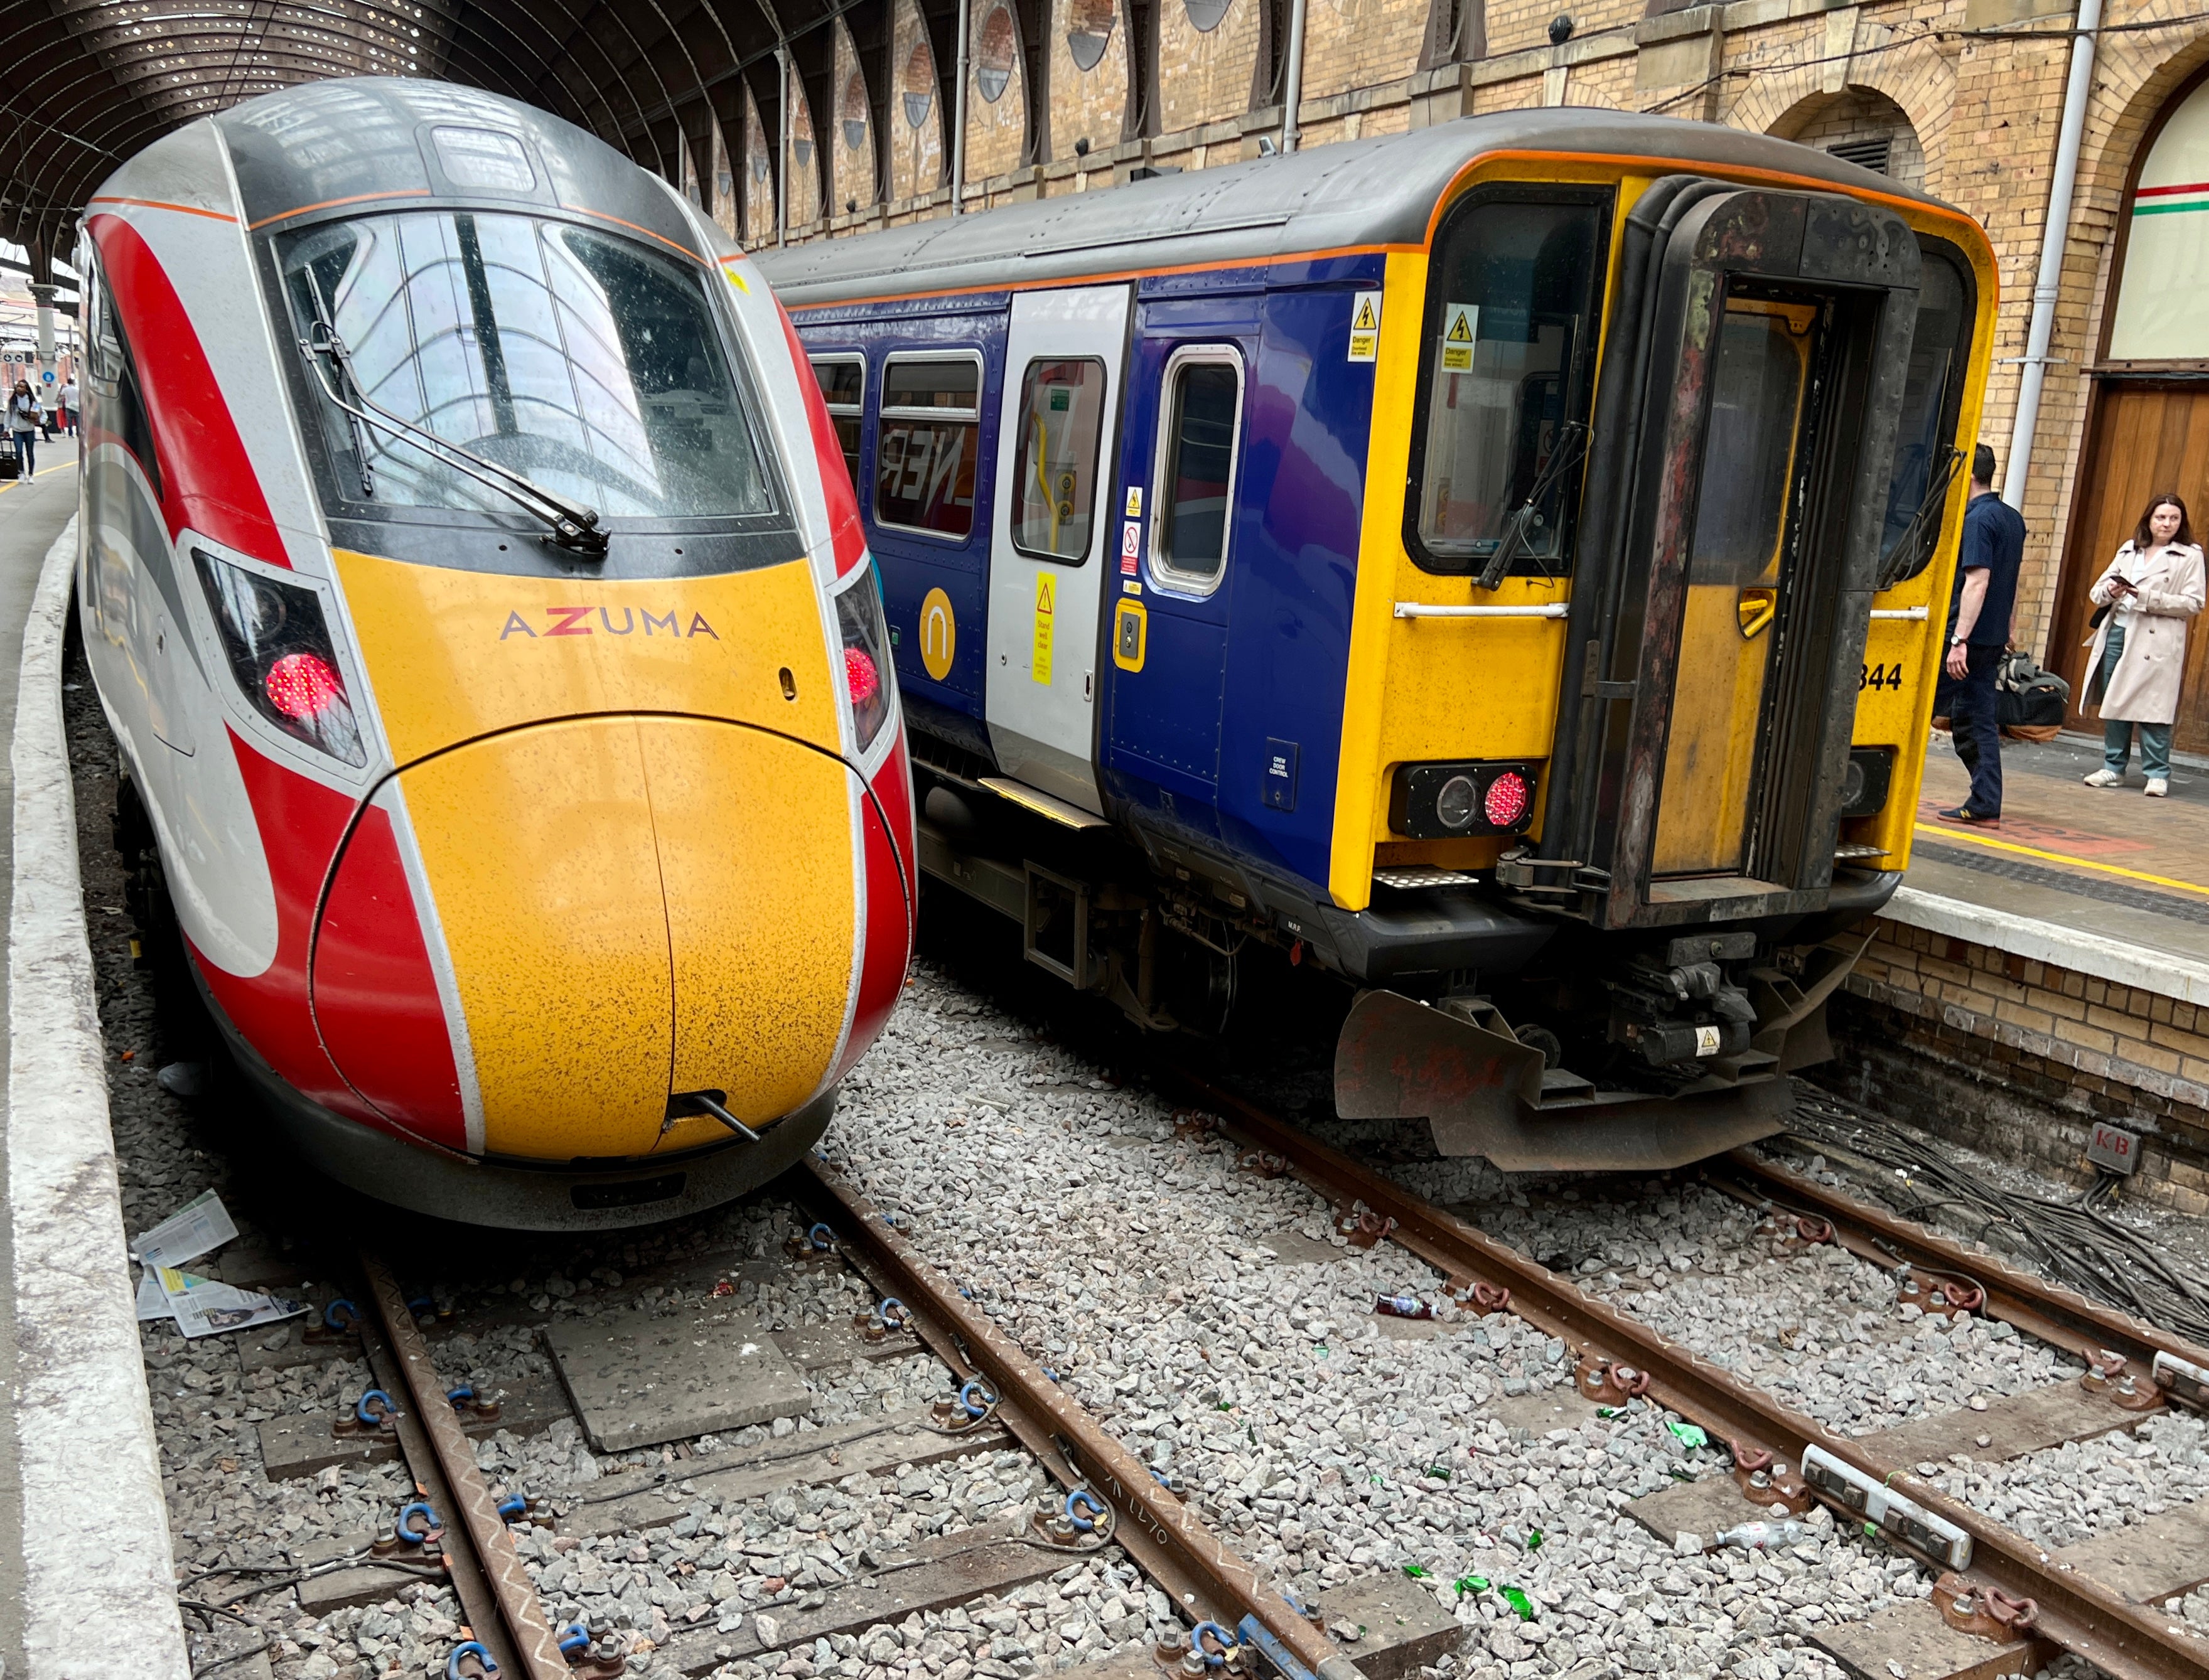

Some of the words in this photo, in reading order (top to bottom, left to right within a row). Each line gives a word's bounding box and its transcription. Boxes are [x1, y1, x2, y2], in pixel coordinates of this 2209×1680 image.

[1353, 336, 1371, 345] Danger
[1446, 347, 1466, 356] Danger
[499, 607, 720, 641] AZUMA
[1037, 619, 1050, 630] Stand
[1040, 632, 1048, 640] well
[1038, 641, 1048, 650] clear
[1273, 762, 1285, 771] DOOR
[1269, 768, 1289, 778] CONTROL
